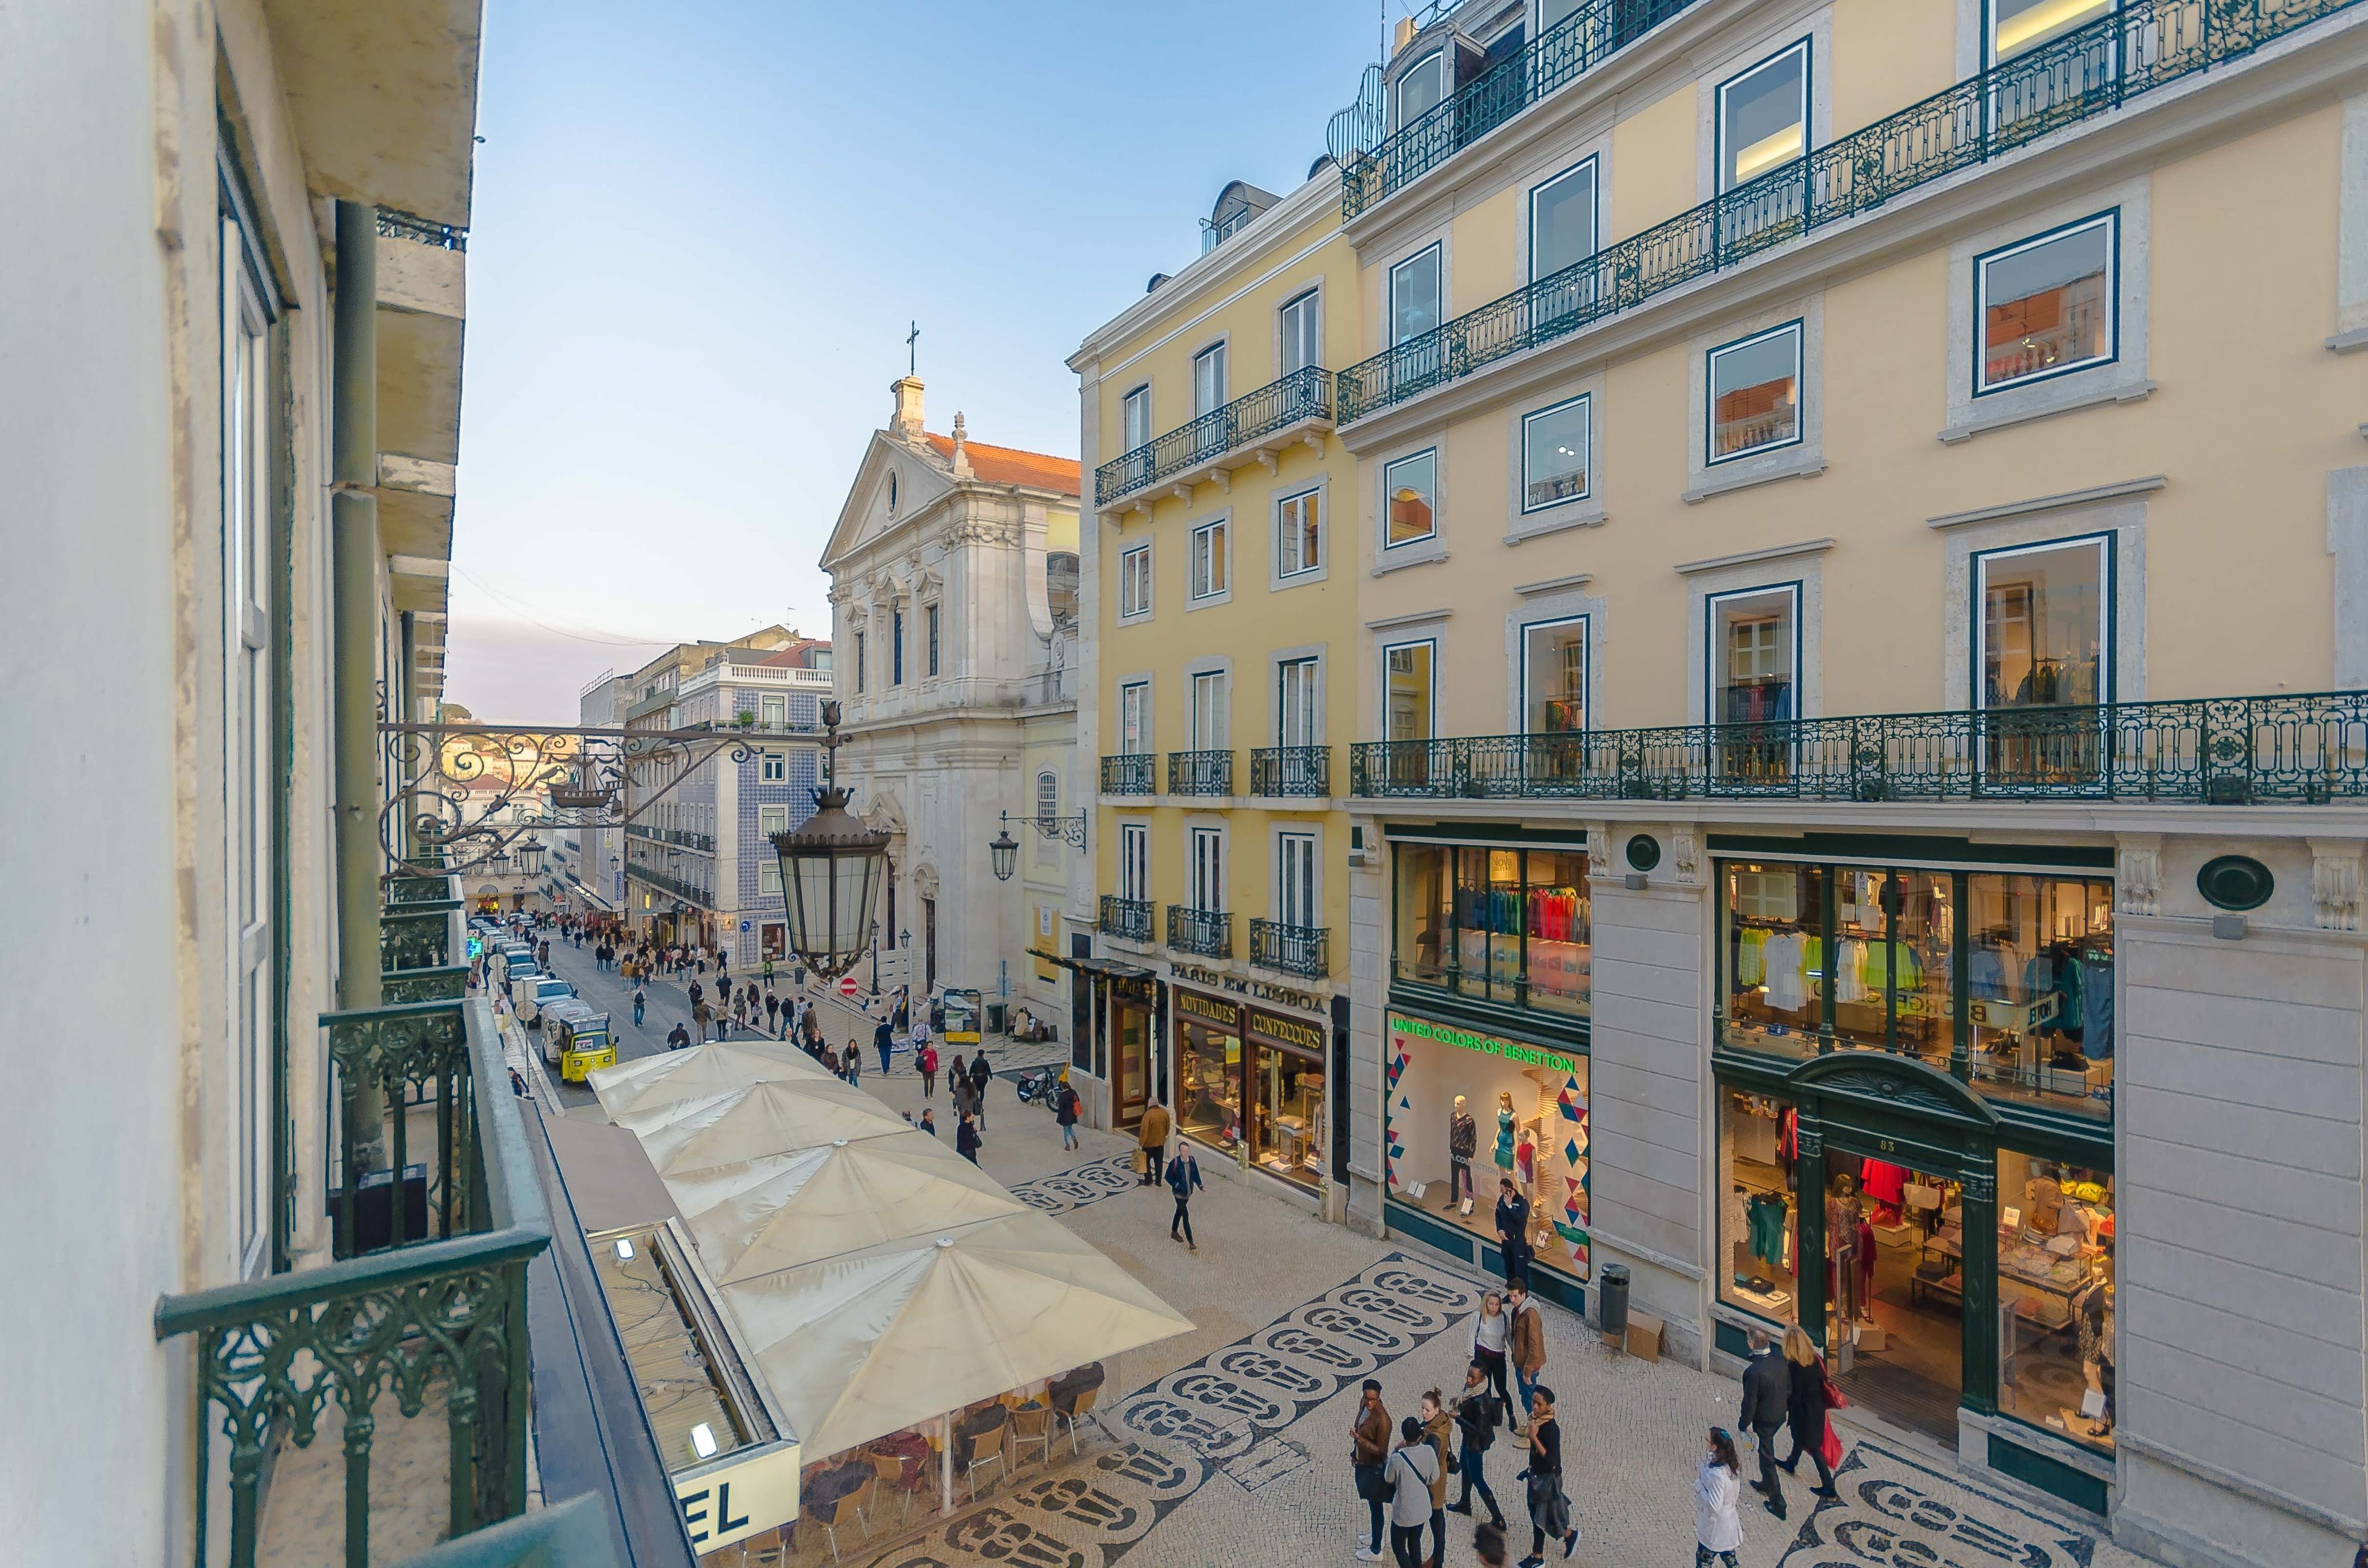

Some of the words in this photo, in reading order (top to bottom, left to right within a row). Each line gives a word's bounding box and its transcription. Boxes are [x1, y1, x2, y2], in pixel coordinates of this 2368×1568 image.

[1170, 963, 1219, 987] PARIS
[1223, 975, 1248, 995] EM
[1252, 982, 1327, 1014] LISBOA
[1180, 994, 1236, 1024] NOVIDADES
[1391, 1017, 1432, 1038] UNITED
[1434, 1028, 1482, 1051] COLORS
[1483, 1039, 1503, 1055] OF
[1880, 1139, 1894, 1152] 83
